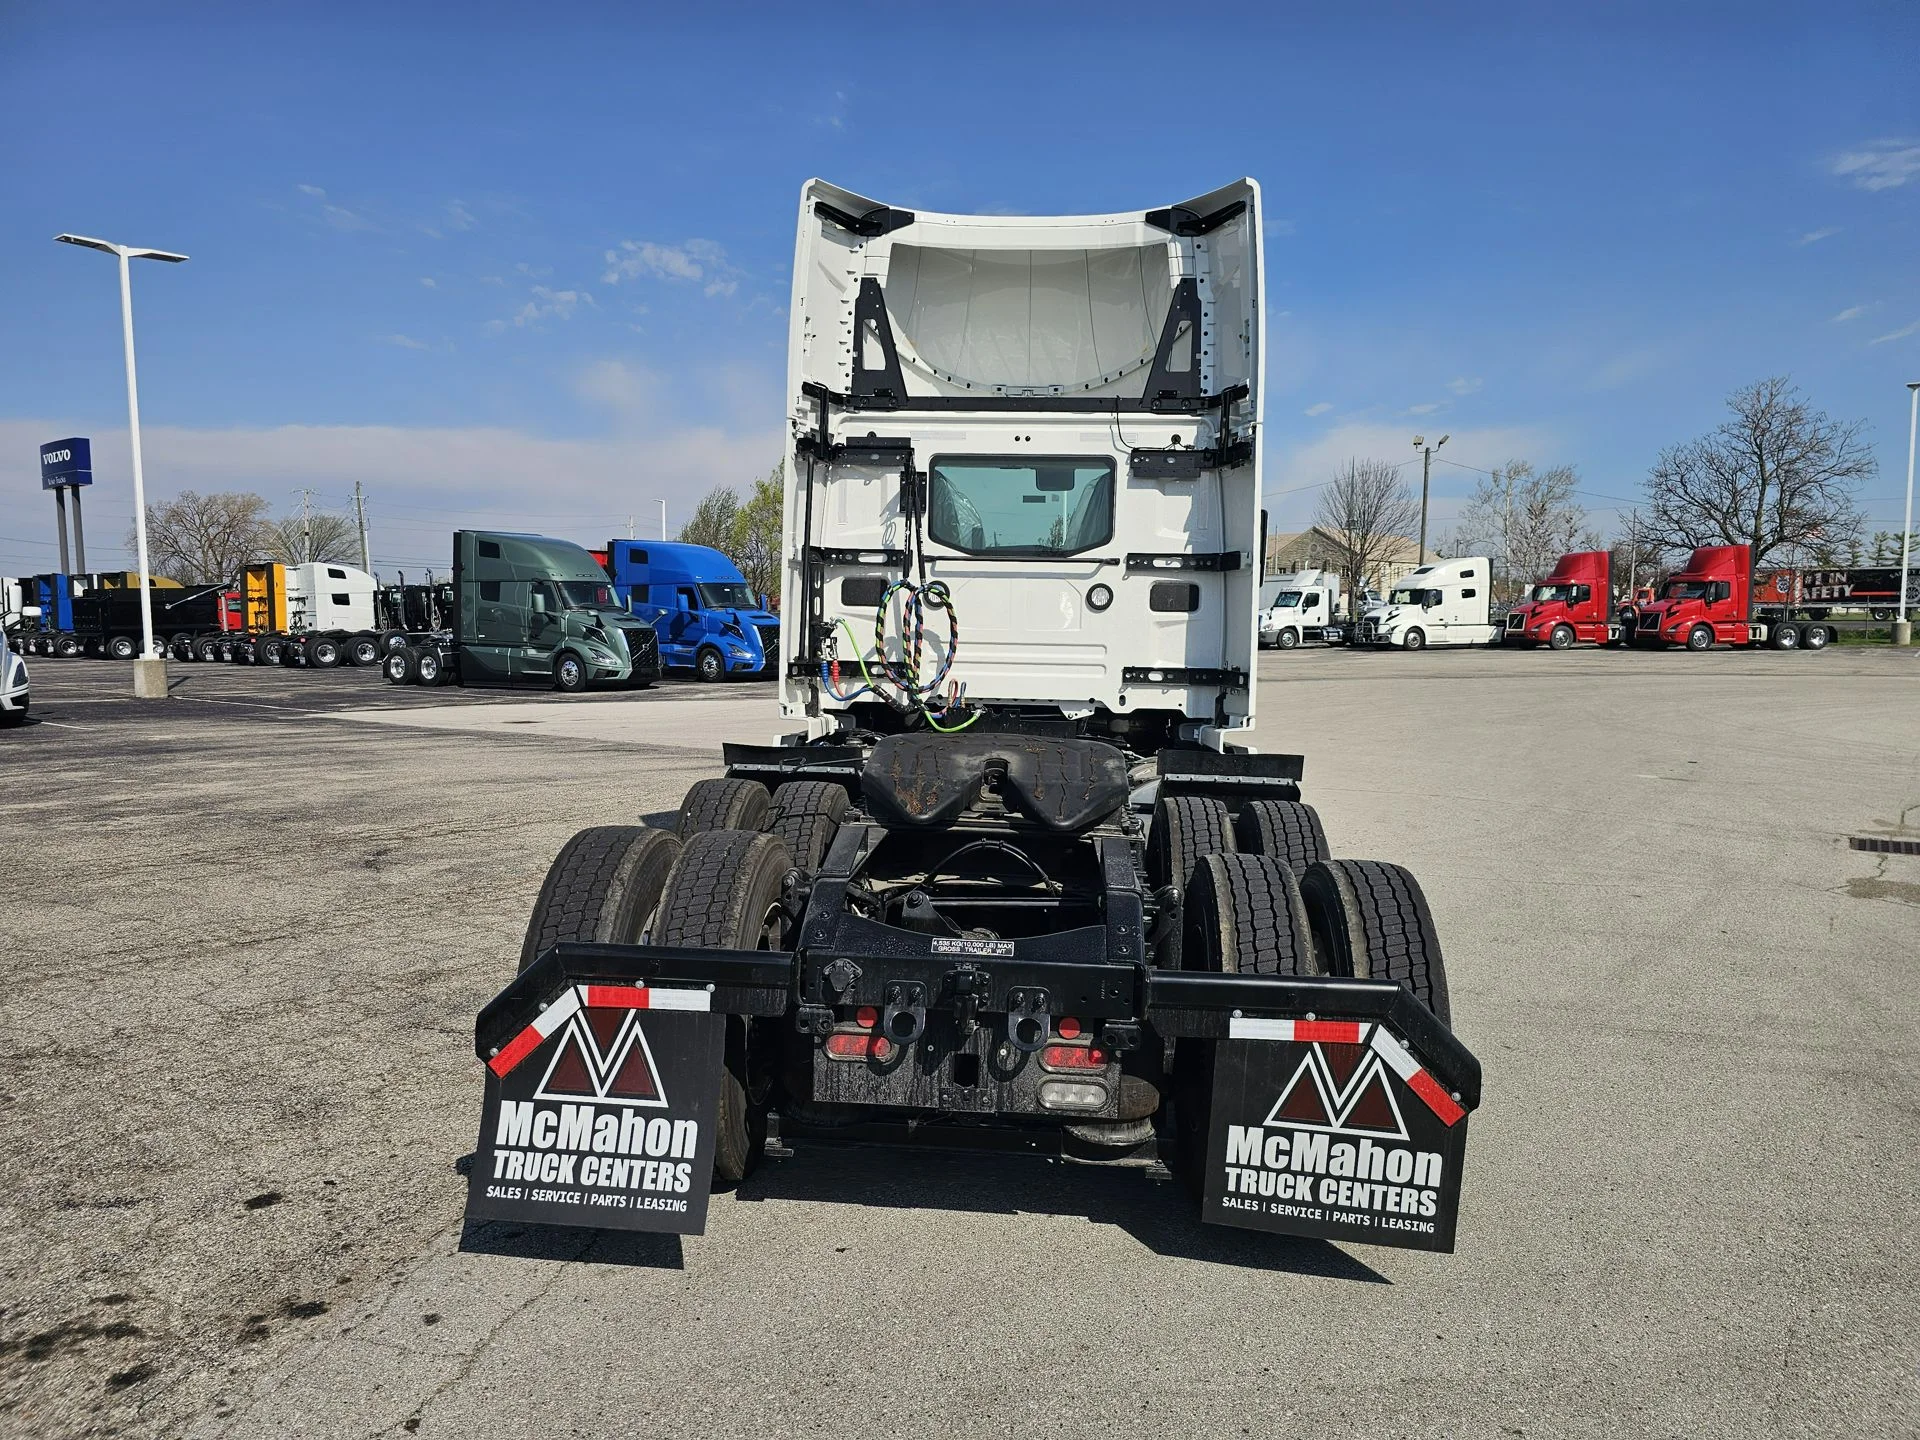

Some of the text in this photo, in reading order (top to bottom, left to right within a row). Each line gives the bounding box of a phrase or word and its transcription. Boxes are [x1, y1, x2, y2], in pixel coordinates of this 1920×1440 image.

[43, 449, 71, 465] VOLVO
[1802, 584, 1855, 599] AFETY
[1829, 572, 1848, 584] IN
[495, 1100, 698, 1159] McMahon
[493, 1149, 692, 1193] TRUCK CENTERS
[1225, 1124, 1443, 1188] McMahon
[486, 1185, 688, 1213] SALES SERVICE PARTS LEASING
[1225, 1166, 1437, 1217] TRUCK CENTERS
[1222, 1196, 1435, 1234] SALES SERVICE PARTS LEASING
